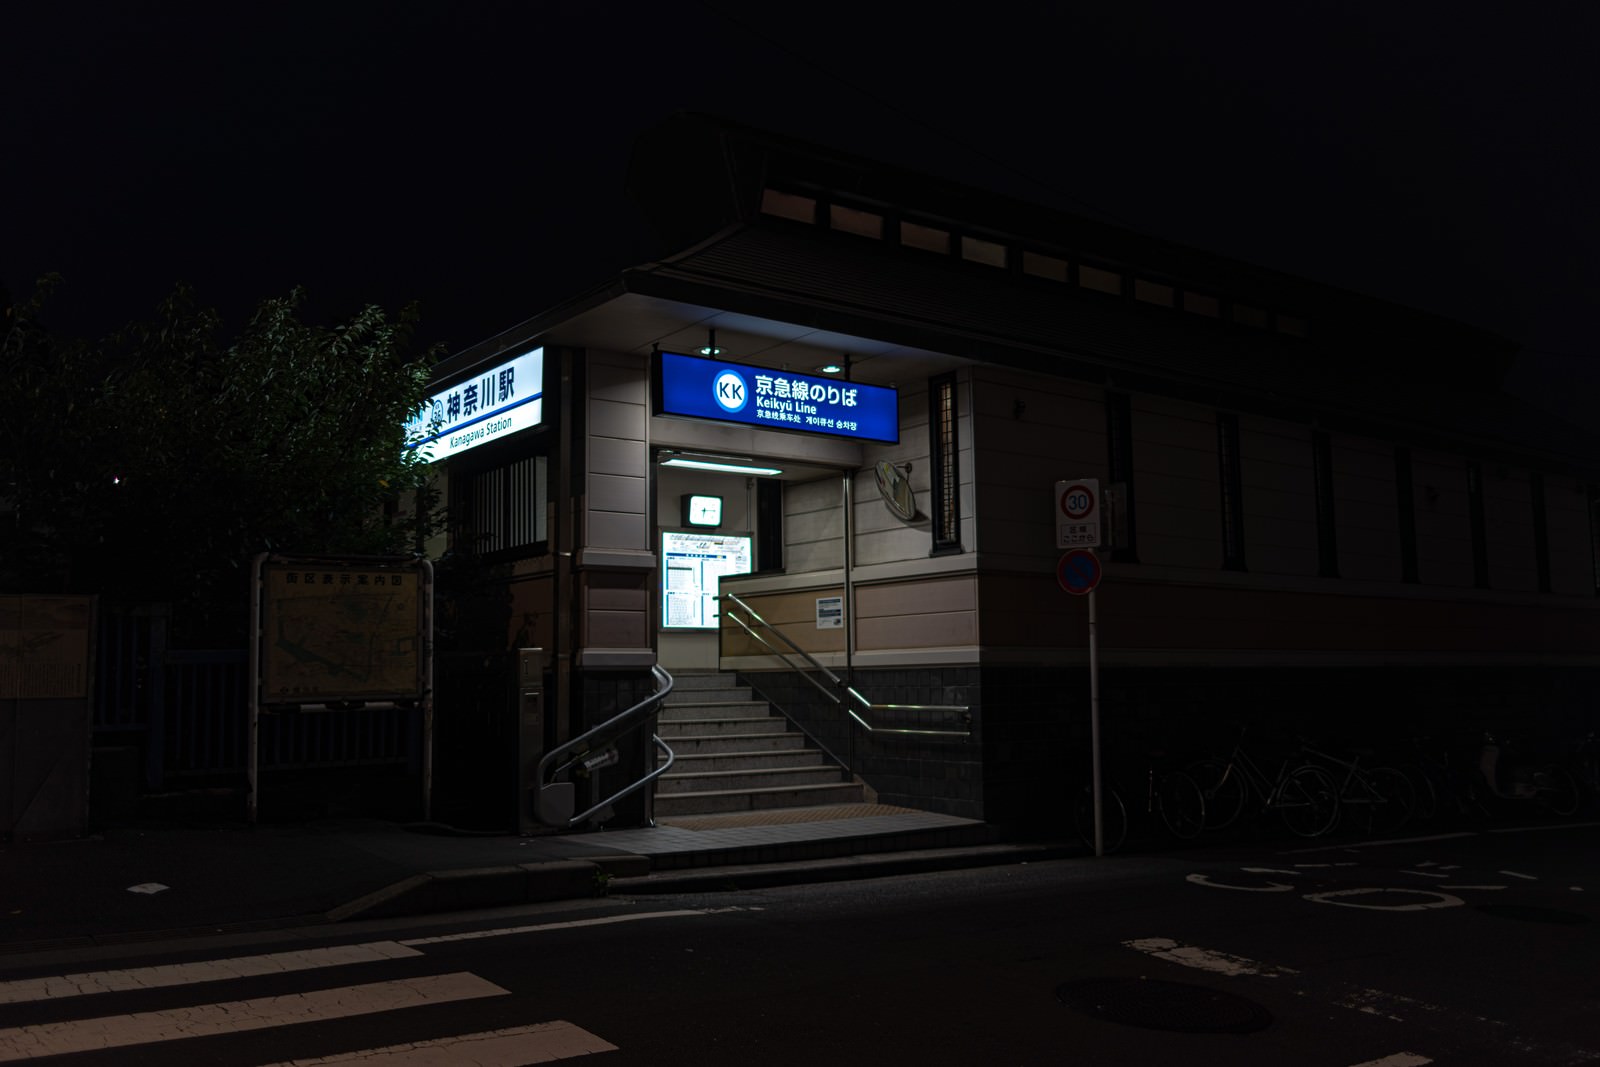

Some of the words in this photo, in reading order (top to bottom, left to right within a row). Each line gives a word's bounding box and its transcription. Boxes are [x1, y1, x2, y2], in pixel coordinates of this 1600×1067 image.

[447, 366, 515, 424] 神奈川駅
[718, 381, 743, 401] KK
[755, 374, 857, 408] 京急線のりば
[756, 395, 793, 413] Keikyū
[795, 401, 817, 415] Line
[449, 428, 485, 449] Kanagawa
[486, 416, 512, 437] Station
[1067, 494, 1088, 511] 30
